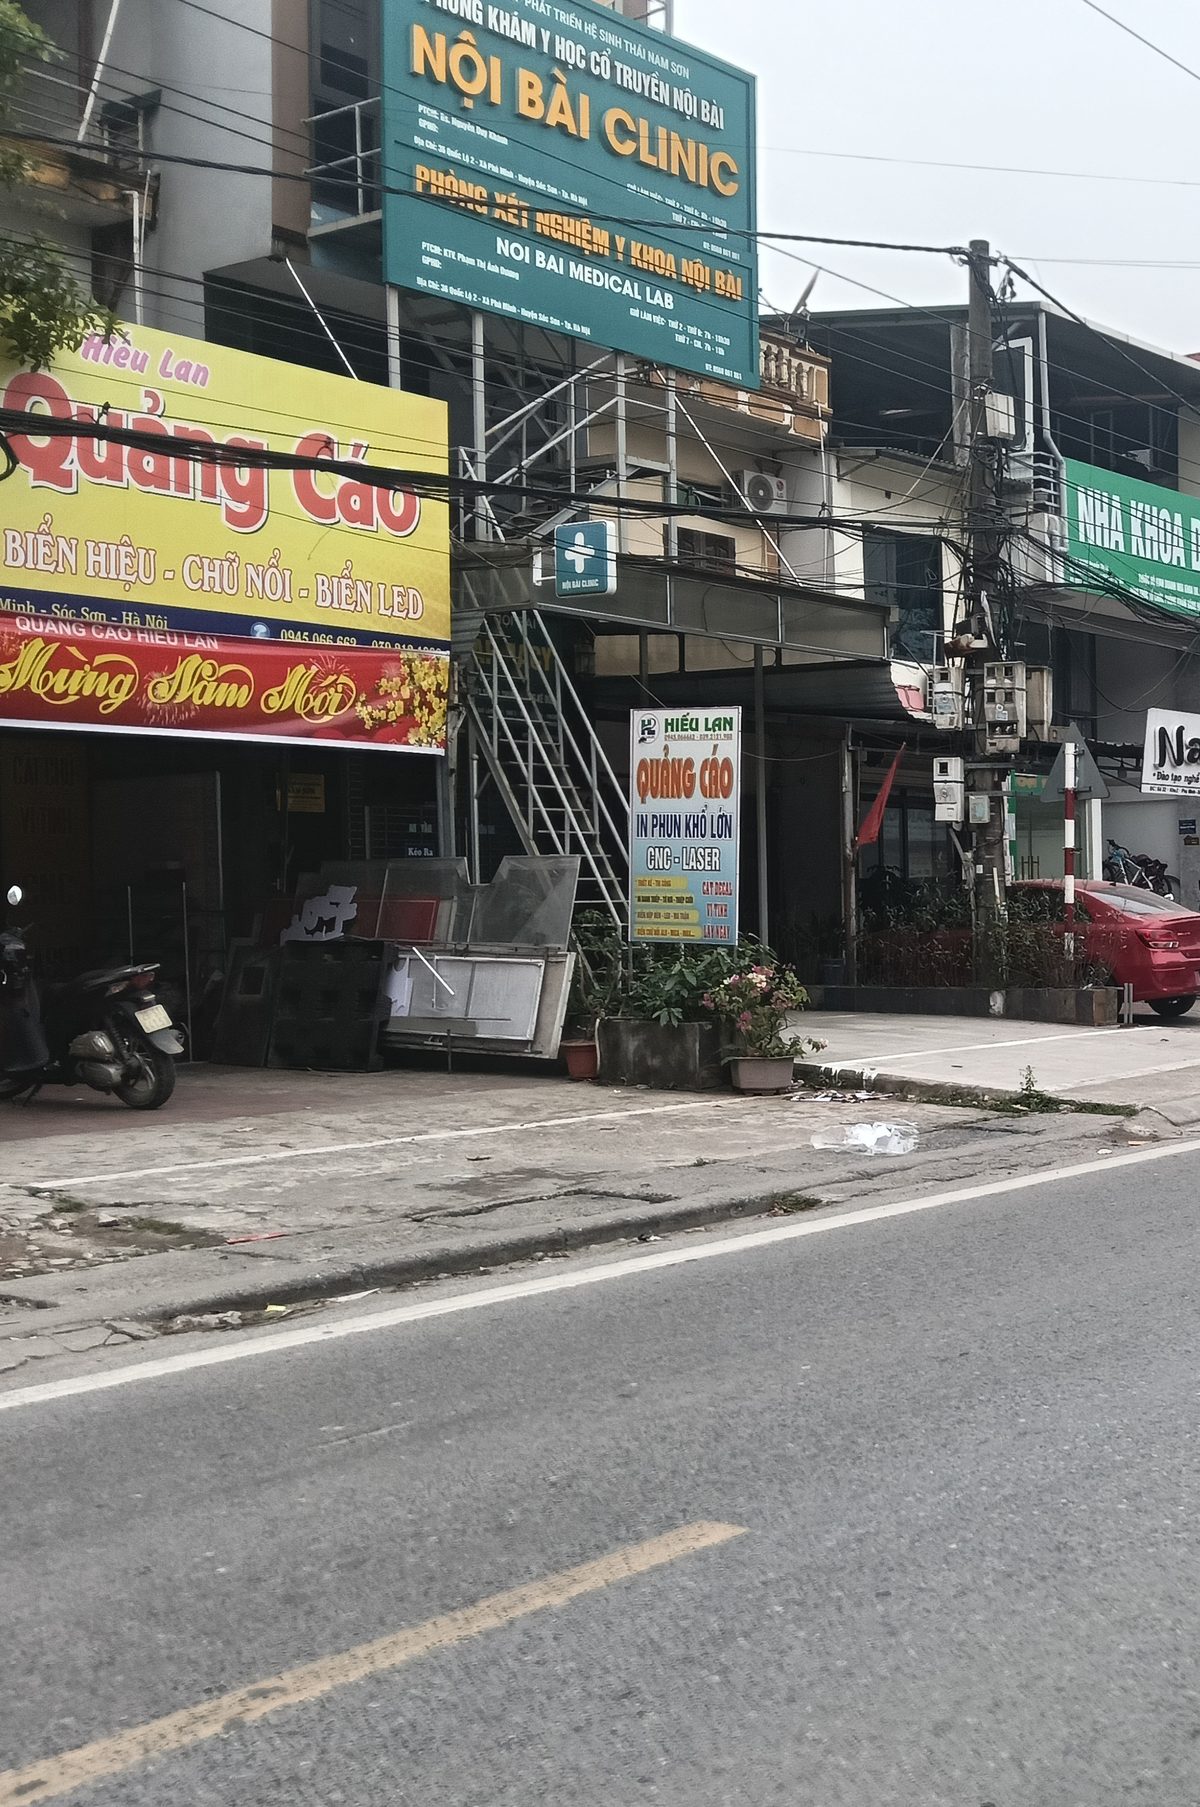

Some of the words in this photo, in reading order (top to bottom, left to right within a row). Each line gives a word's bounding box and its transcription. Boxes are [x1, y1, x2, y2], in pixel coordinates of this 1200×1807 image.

[487, 4, 537, 49] KHÁM
[540, 27, 550, 54] Y
[554, 34, 587, 70] HỌC
[590, 46, 612, 80] CỔ
[614, 60, 670, 107] TRUYỀN
[673, 86, 698, 121] NỘI
[701, 98, 725, 131] BÀI
[584, 21, 598, 40] HỆ
[599, 29, 623, 50] SINH
[624, 39, 647, 61] THÁI
[648, 50, 669, 71] NAM
[670, 61, 690, 80] SƠN
[411, 23, 502, 109] NỘI
[516, 67, 590, 141] BÀI
[603, 106, 739, 198] CLINIC
[415, 163, 488, 215] PHÒNG
[494, 191, 530, 228] XÉT
[535, 209, 610, 257] NGHIỆM
[615, 234, 626, 261] Y
[630, 239, 678, 280] KHOA
[681, 256, 712, 294] NỘI
[715, 270, 744, 302] BÀI
[496, 237, 531, 264] NOI
[535, 250, 564, 276] BAI
[568, 261, 642, 301] MEDICAL
[645, 286, 674, 310] LAB
[159, 349, 209, 387] Lan
[3, 371, 269, 533] Quảng
[294, 429, 420, 537] Cáo
[4, 514, 78, 577] BIỂN
[86, 537, 156, 592] HIỆU
[183, 552, 240, 595] CHỮ
[245, 547, 293, 603] NỔI
[315, 560, 373, 614] BIỂN
[376, 584, 425, 620] LED
[1077, 486, 1125, 552] NHA
[1130, 500, 1187, 570] KHOA
[0, 636, 139, 714] Mừng
[147, 653, 255, 710] Năm
[260, 662, 357, 724] Mới
[704, 717, 734, 733] LAN
[636, 743, 697, 804] QUẢNG
[700, 743, 734, 800] CÁO
[636, 813, 648, 839] IN
[651, 813, 682, 839] PHUN
[684, 804, 708, 839] KHỔ
[710, 805, 733, 839] LỚN
[646, 846, 673, 872] CNC
[682, 847, 721, 872] LASER
